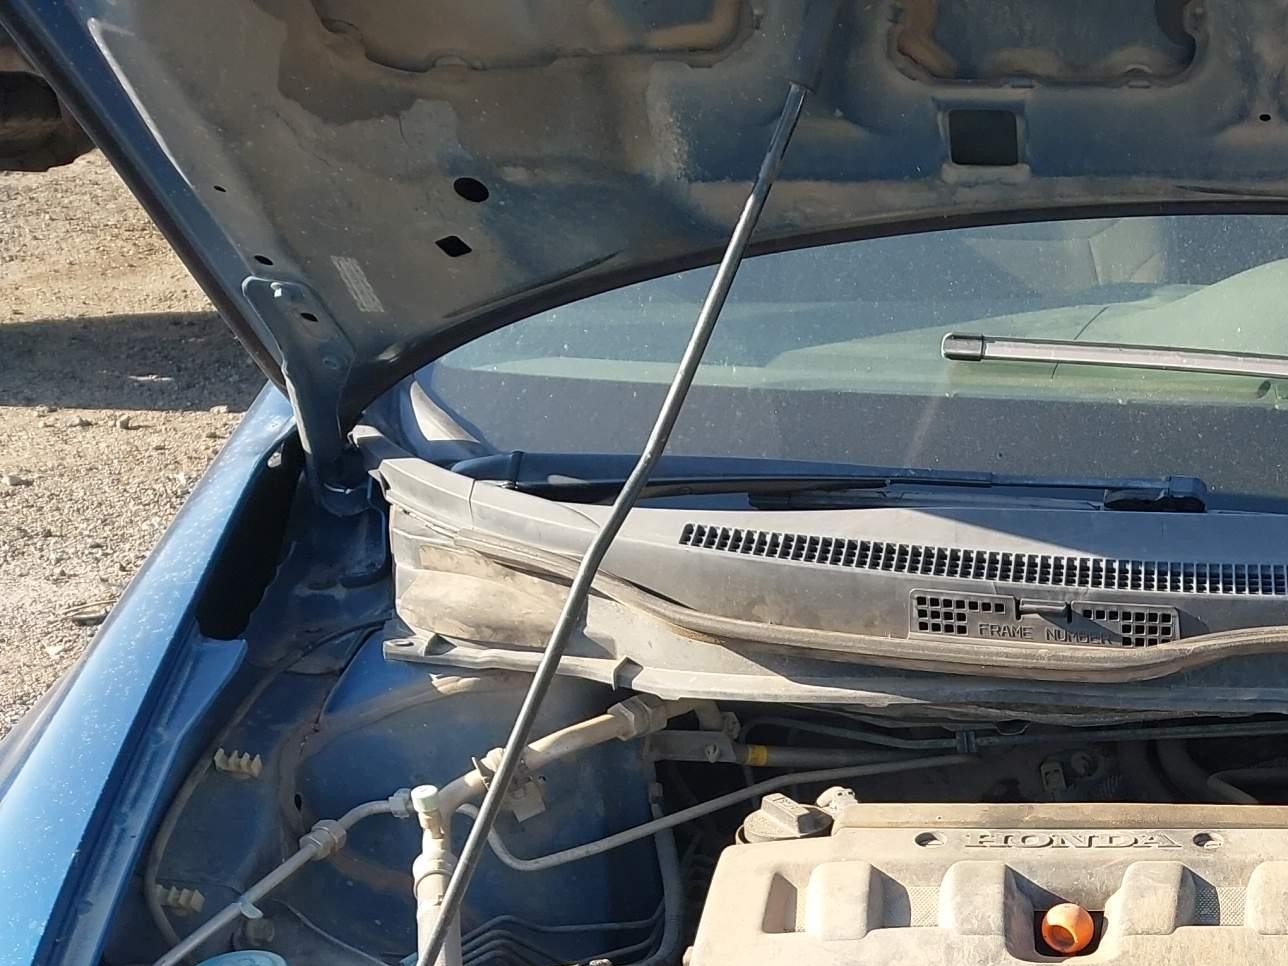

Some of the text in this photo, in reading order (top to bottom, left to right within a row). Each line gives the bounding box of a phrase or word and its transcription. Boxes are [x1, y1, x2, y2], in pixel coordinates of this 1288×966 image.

[978, 623, 1113, 645] FRAME NUMBER
[964, 832, 1183, 848] HONDA
